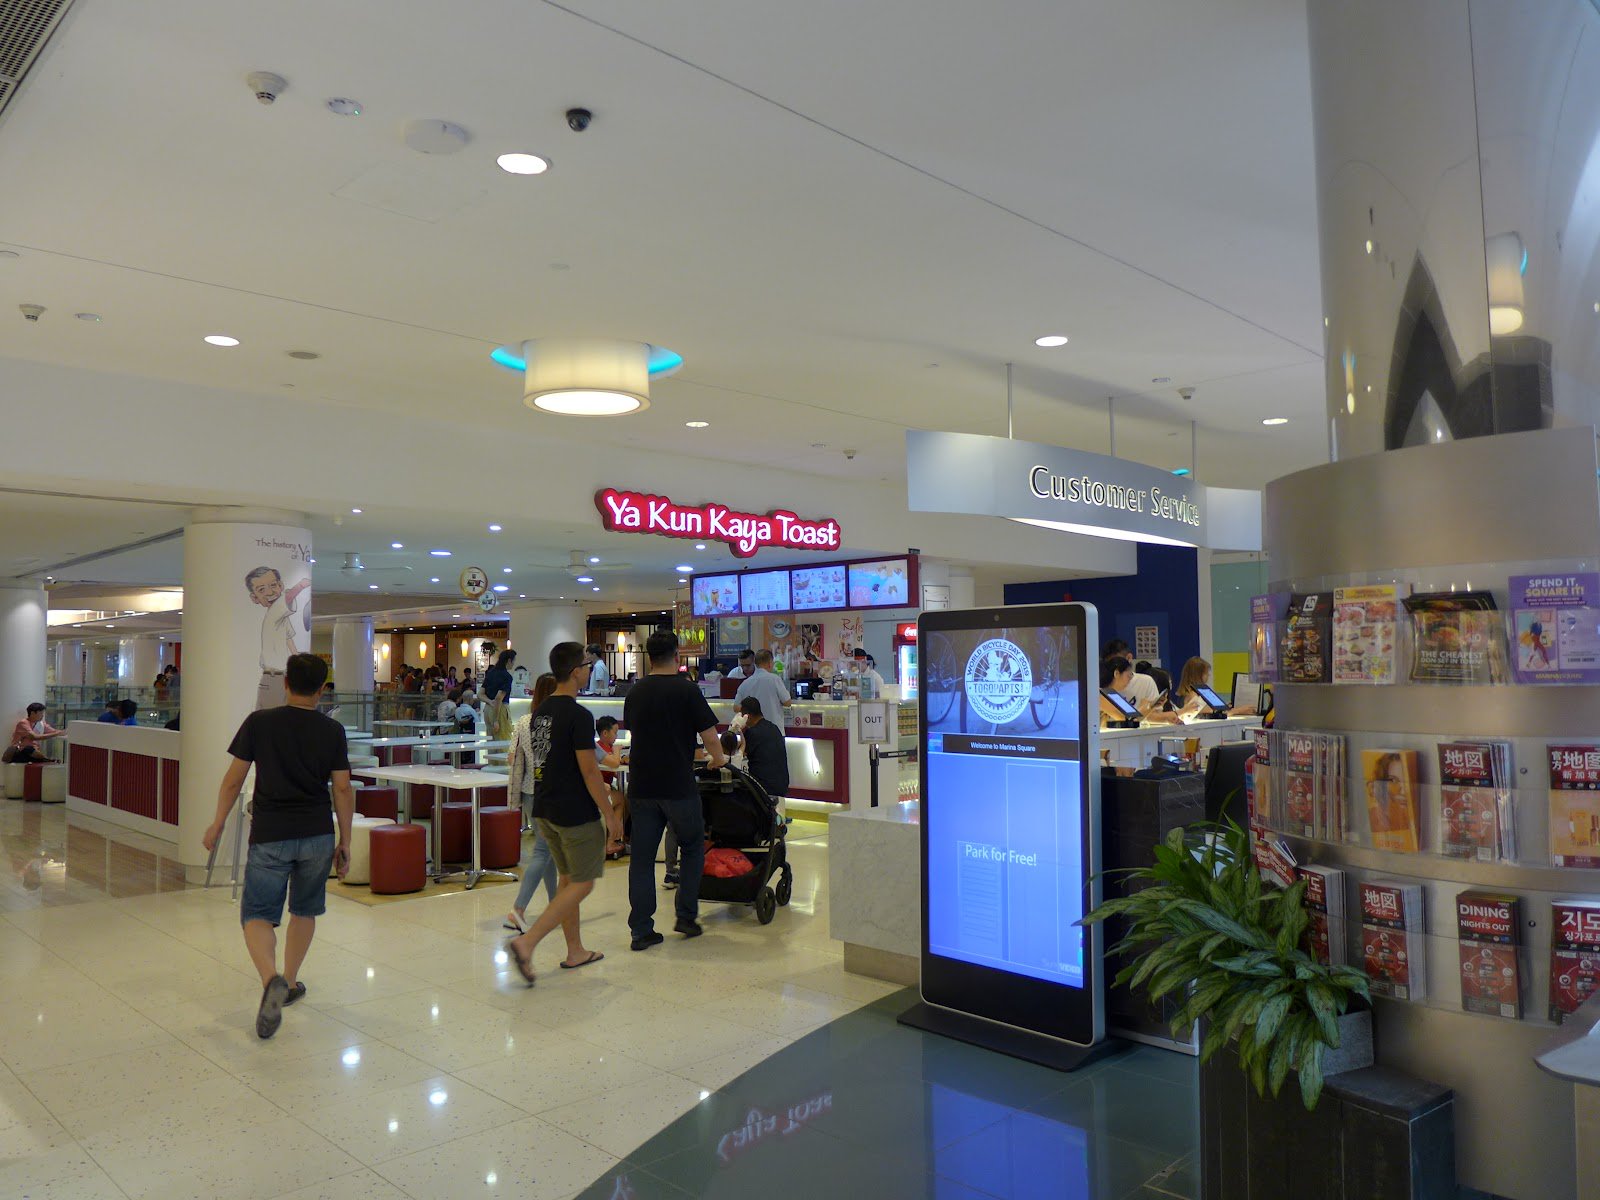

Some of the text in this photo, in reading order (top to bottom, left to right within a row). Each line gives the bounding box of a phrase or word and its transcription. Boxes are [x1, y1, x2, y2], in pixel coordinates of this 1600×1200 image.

[1029, 464, 1200, 527] Customer Service
[607, 496, 837, 552] Ya Kun Kaya Toast
[256, 538, 271, 547] The
[1529, 578, 1563, 588] SPEND
[1525, 587, 1568, 597] SQUARE
[967, 640, 1031, 676] WORLD BICYCLE DAY 2019
[1440, 651, 1483, 659] CHEAPEST
[864, 716, 882, 724] OUT
[971, 742, 993, 750] Welcome
[1017, 744, 1035, 753] Square
[1288, 739, 1312, 753] MAP
[1444, 750, 1484, 769] 地図
[966, 844, 1037, 867] Park for Free!
[1364, 889, 1396, 910] 地図
[1460, 904, 1509, 919] DINING
[1461, 920, 1510, 931] NIGHTS OUT
